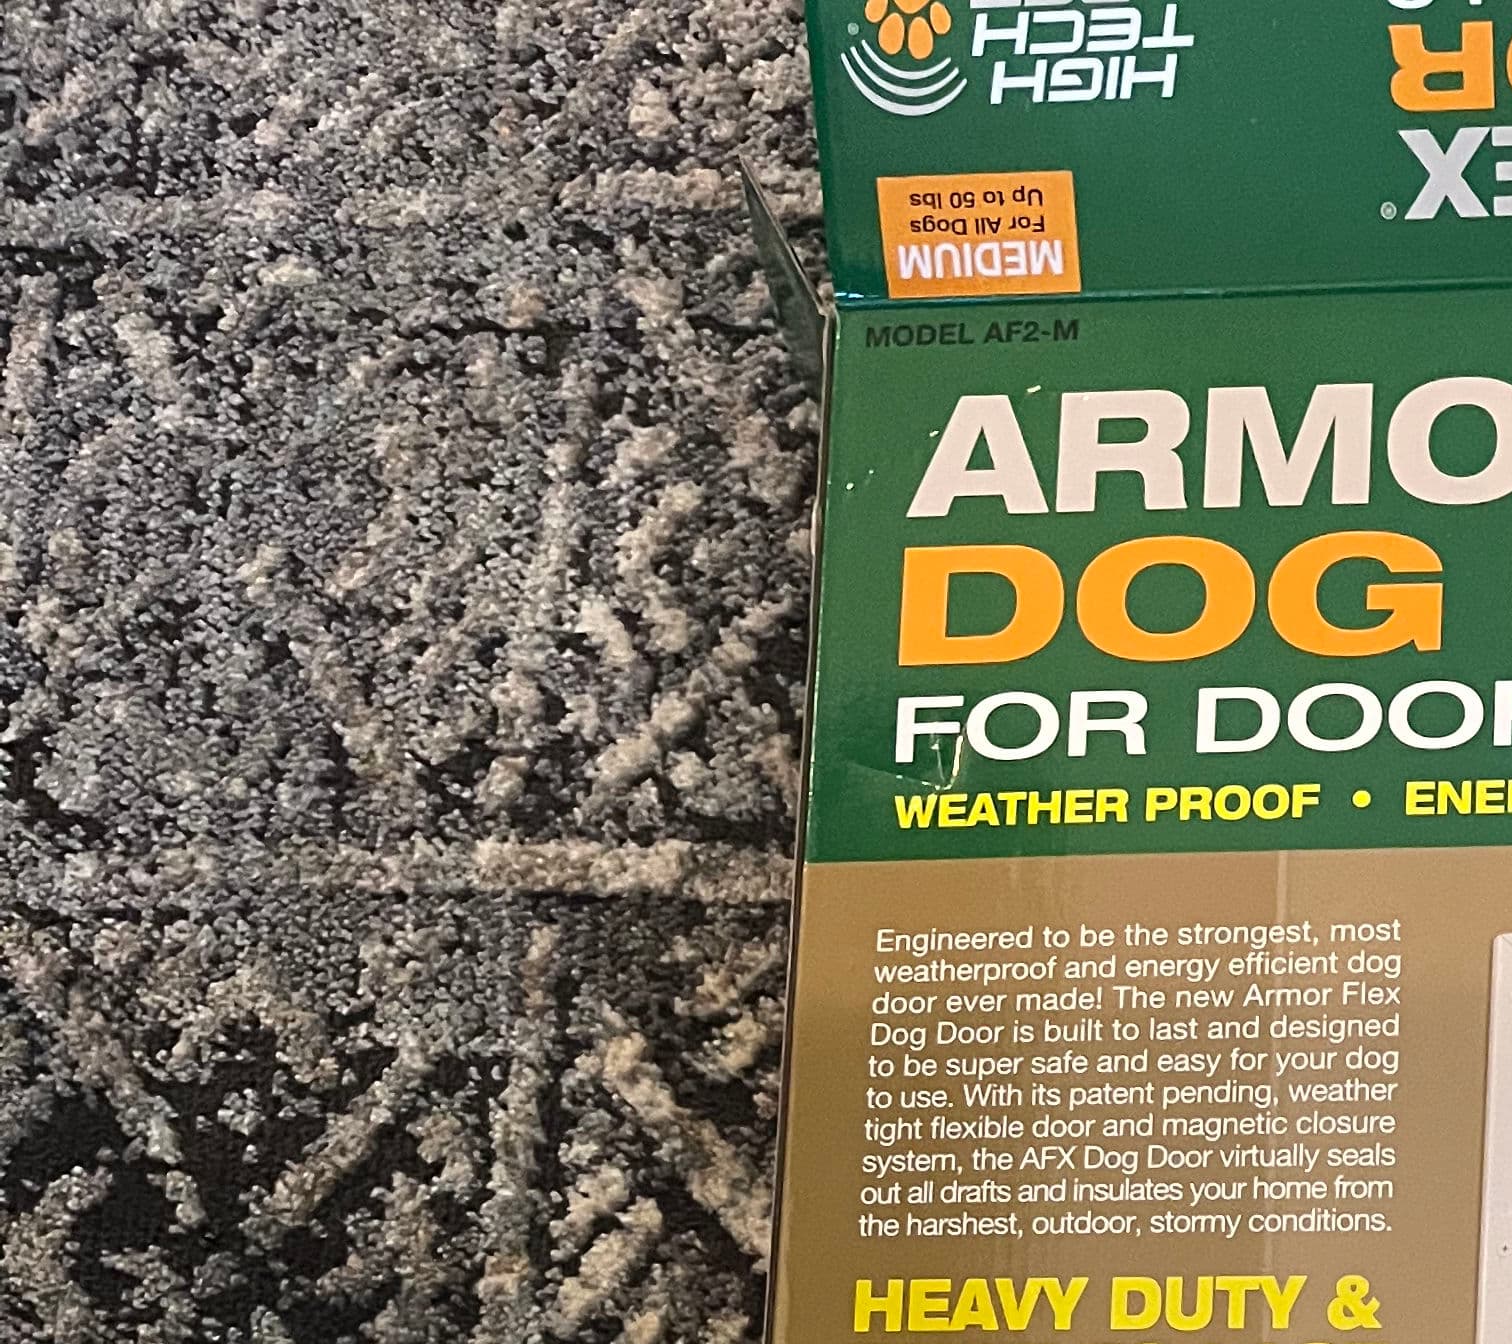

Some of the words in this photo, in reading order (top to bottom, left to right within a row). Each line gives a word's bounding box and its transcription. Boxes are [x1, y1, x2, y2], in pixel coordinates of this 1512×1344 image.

[971, 4, 1194, 57] TECH
[990, 53, 1178, 104] HIGH
[909, 192, 942, 209] lbs
[950, 191, 975, 208] 50
[983, 191, 1004, 207] to
[1012, 186, 1043, 206] Up
[910, 216, 968, 235] Dogs
[976, 217, 1001, 234] All
[1009, 216, 1045, 232] For
[898, 239, 1064, 280] MEDIUM
[865, 323, 974, 348] MODEL
[984, 319, 1079, 343] AF2-M
[898, 529, 1444, 666] DOG
[894, 690, 1149, 764] FOR
[894, 788, 1131, 830] WEATHER
[1144, 784, 1322, 822] PROOF
[876, 926, 1033, 957] Engineered
[1043, 925, 1071, 949] to
[1079, 923, 1115, 949] be
[1124, 922, 1169, 947] the
[1178, 922, 1319, 951] strongest,
[1329, 918, 1402, 943] most
[874, 957, 1059, 986] weatherproof
[1064, 955, 1117, 979] and
[1125, 958, 1220, 983] energy
[1228, 951, 1338, 976] efficient
[1346, 950, 1402, 978] dog
[853, 1277, 1088, 1333] HEAVY
[1110, 1275, 1308, 1331] DUTY
[1327, 1274, 1382, 1331] &
